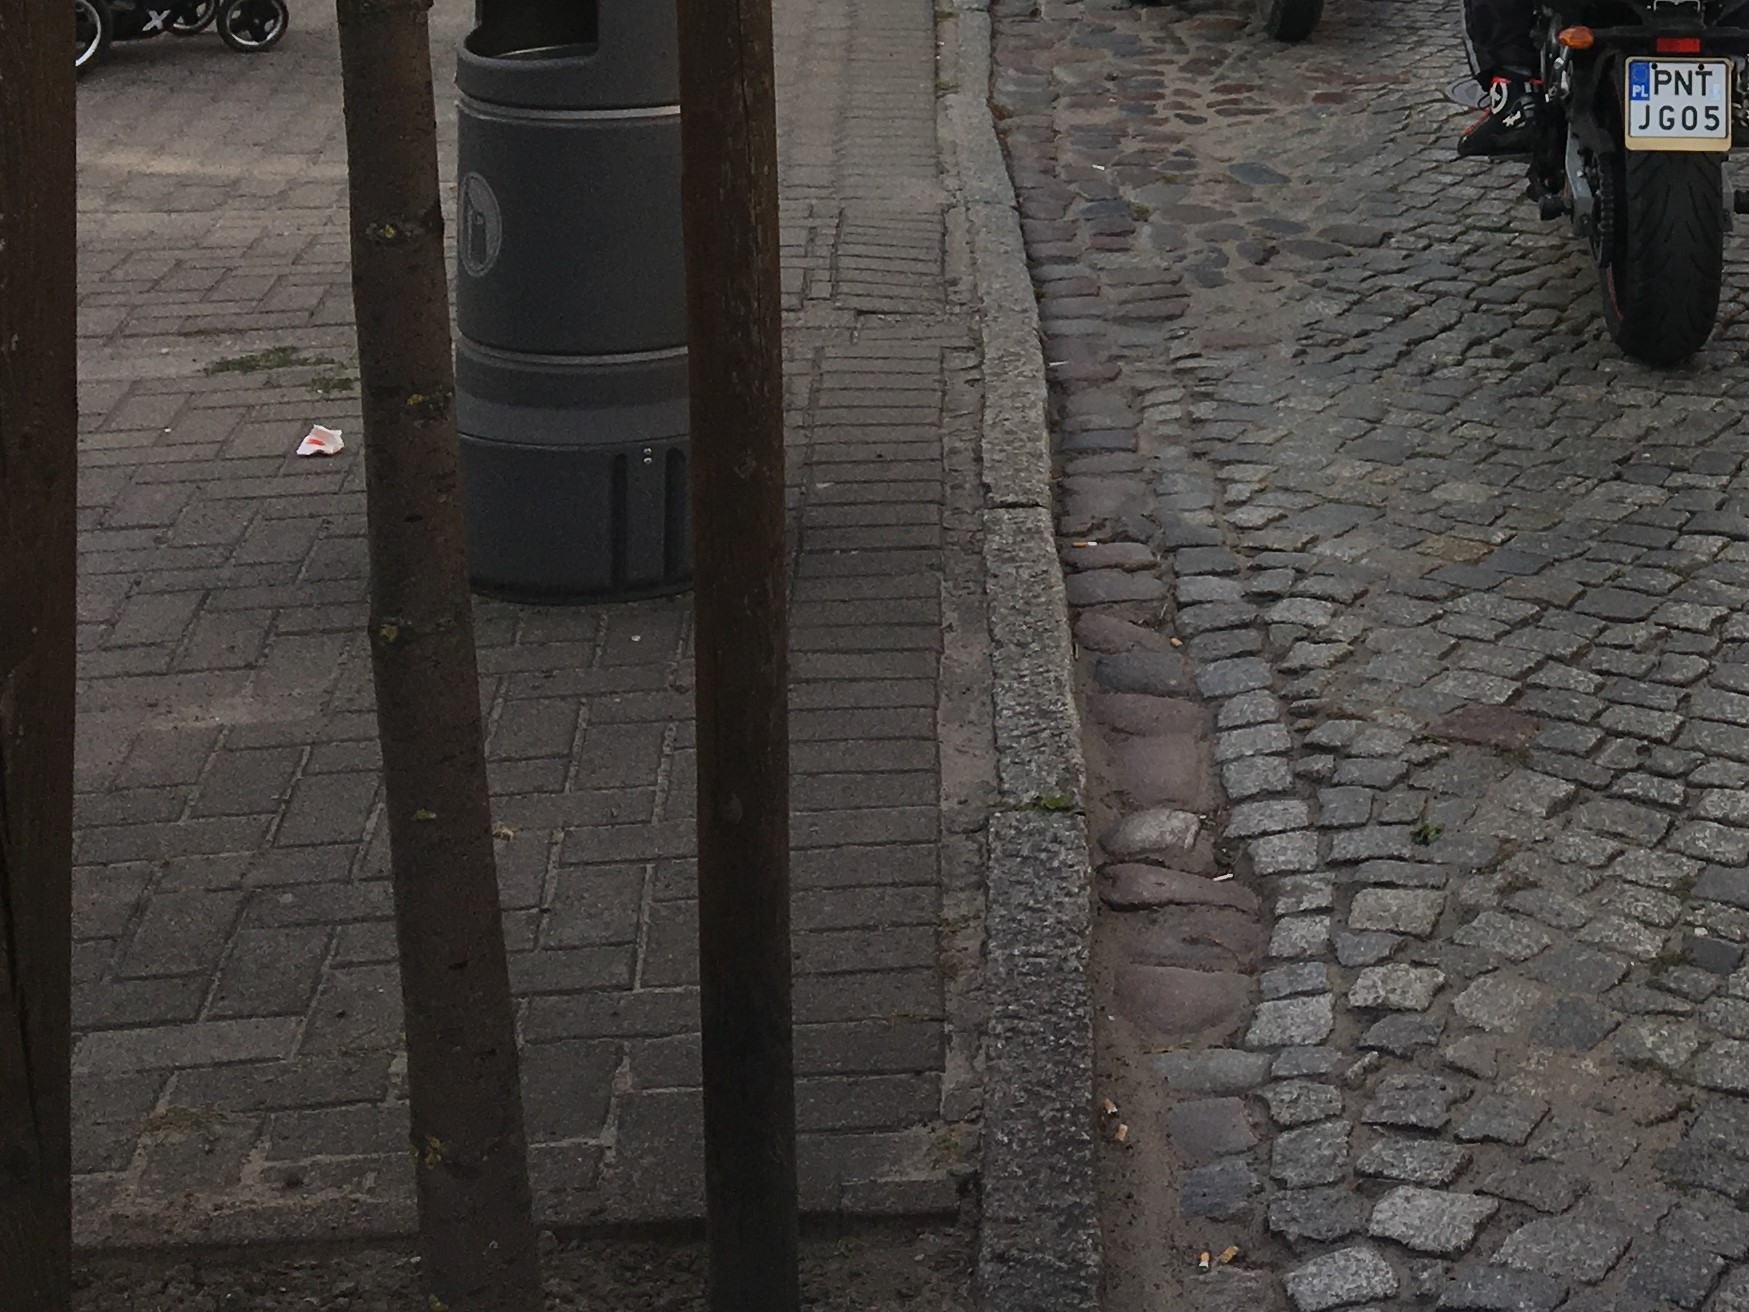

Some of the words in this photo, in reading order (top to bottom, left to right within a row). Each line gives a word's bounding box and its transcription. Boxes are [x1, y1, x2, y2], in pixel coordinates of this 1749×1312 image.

[1632, 85, 1648, 97] PL
[1654, 70, 1712, 96] PNT
[1638, 104, 1720, 131] JG05
